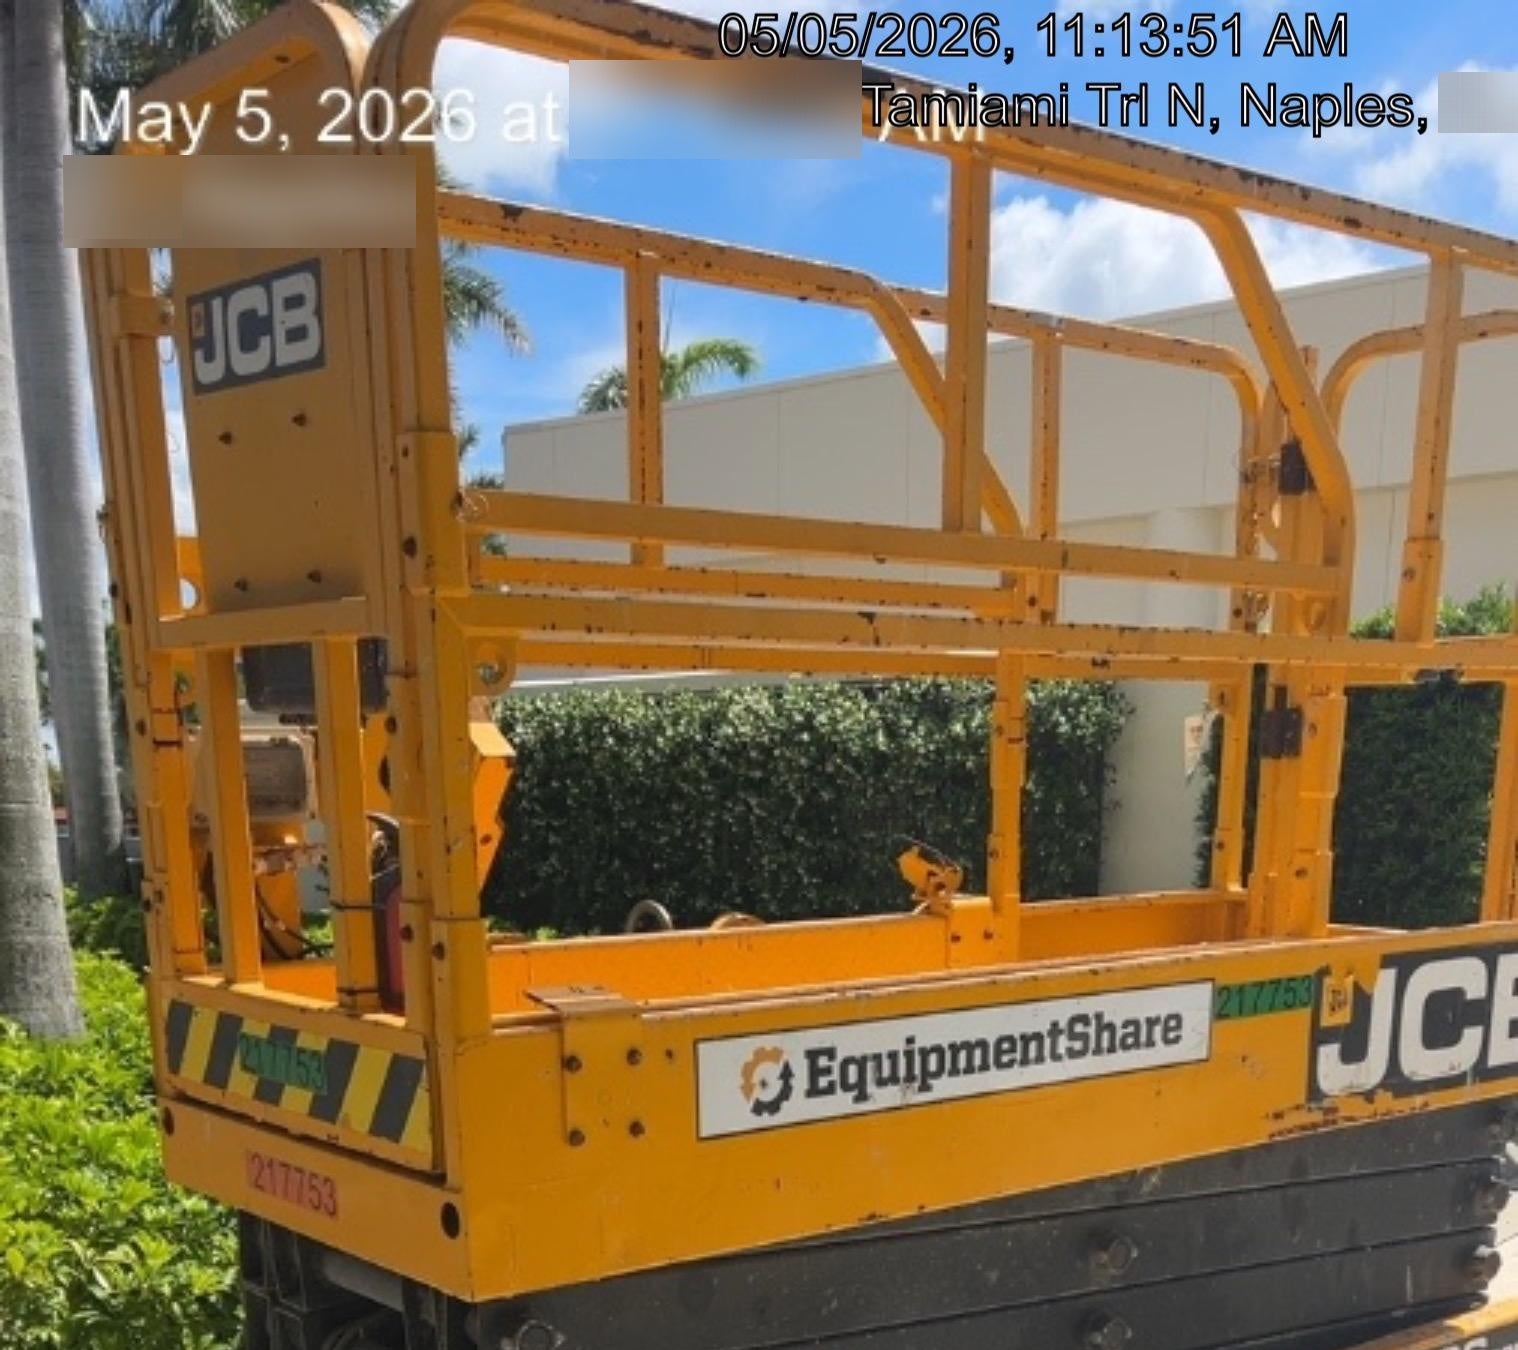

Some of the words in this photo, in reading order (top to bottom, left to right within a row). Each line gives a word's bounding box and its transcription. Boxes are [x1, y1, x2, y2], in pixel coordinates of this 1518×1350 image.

[194, 271, 321, 385] JCB
[1216, 975, 1313, 1019] 217753
[804, 1010, 1184, 1103] EquipmentShare
[249, 1152, 338, 1219] 217753
